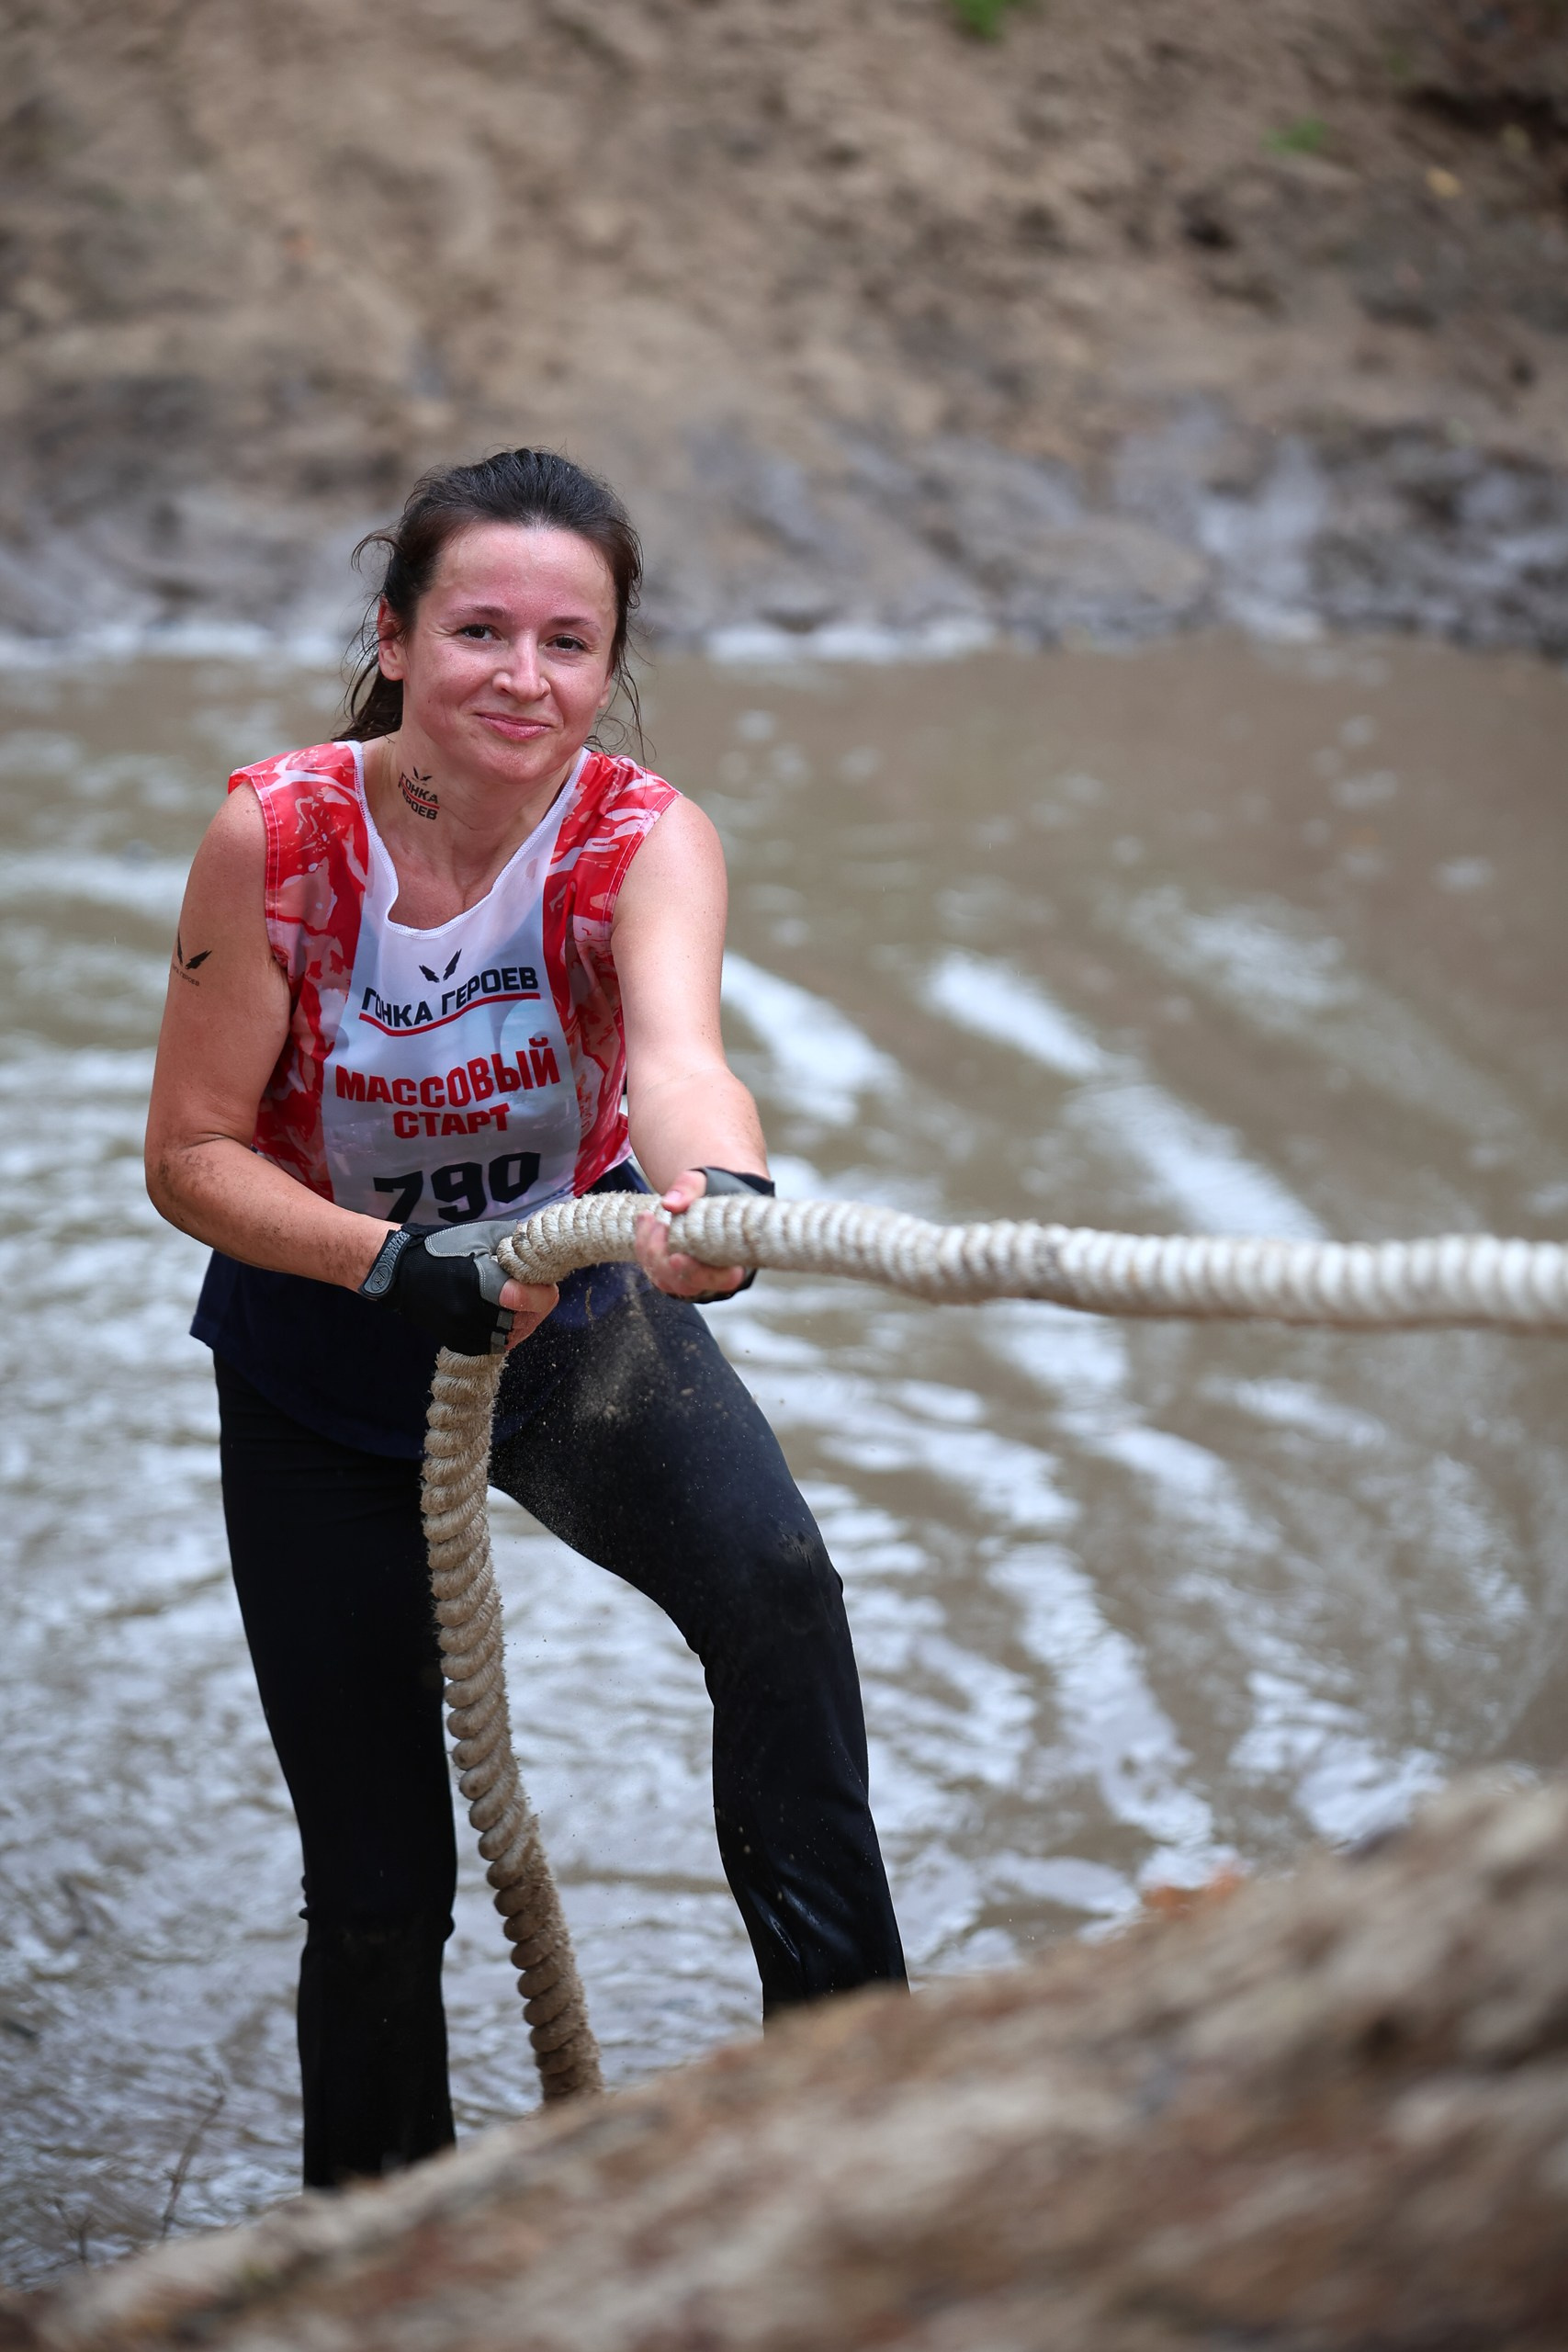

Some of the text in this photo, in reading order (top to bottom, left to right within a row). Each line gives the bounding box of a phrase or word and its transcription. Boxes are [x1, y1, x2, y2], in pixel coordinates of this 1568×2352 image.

[399, 772, 439, 804] ГОНКА
[361, 967, 539, 1028] ГОНКА ГЕРОЕВ
[335, 1036, 561, 1108] МАССОВЫЙ
[393, 1102, 511, 1139] СТАРТ
[373, 1151, 541, 1224] 790
